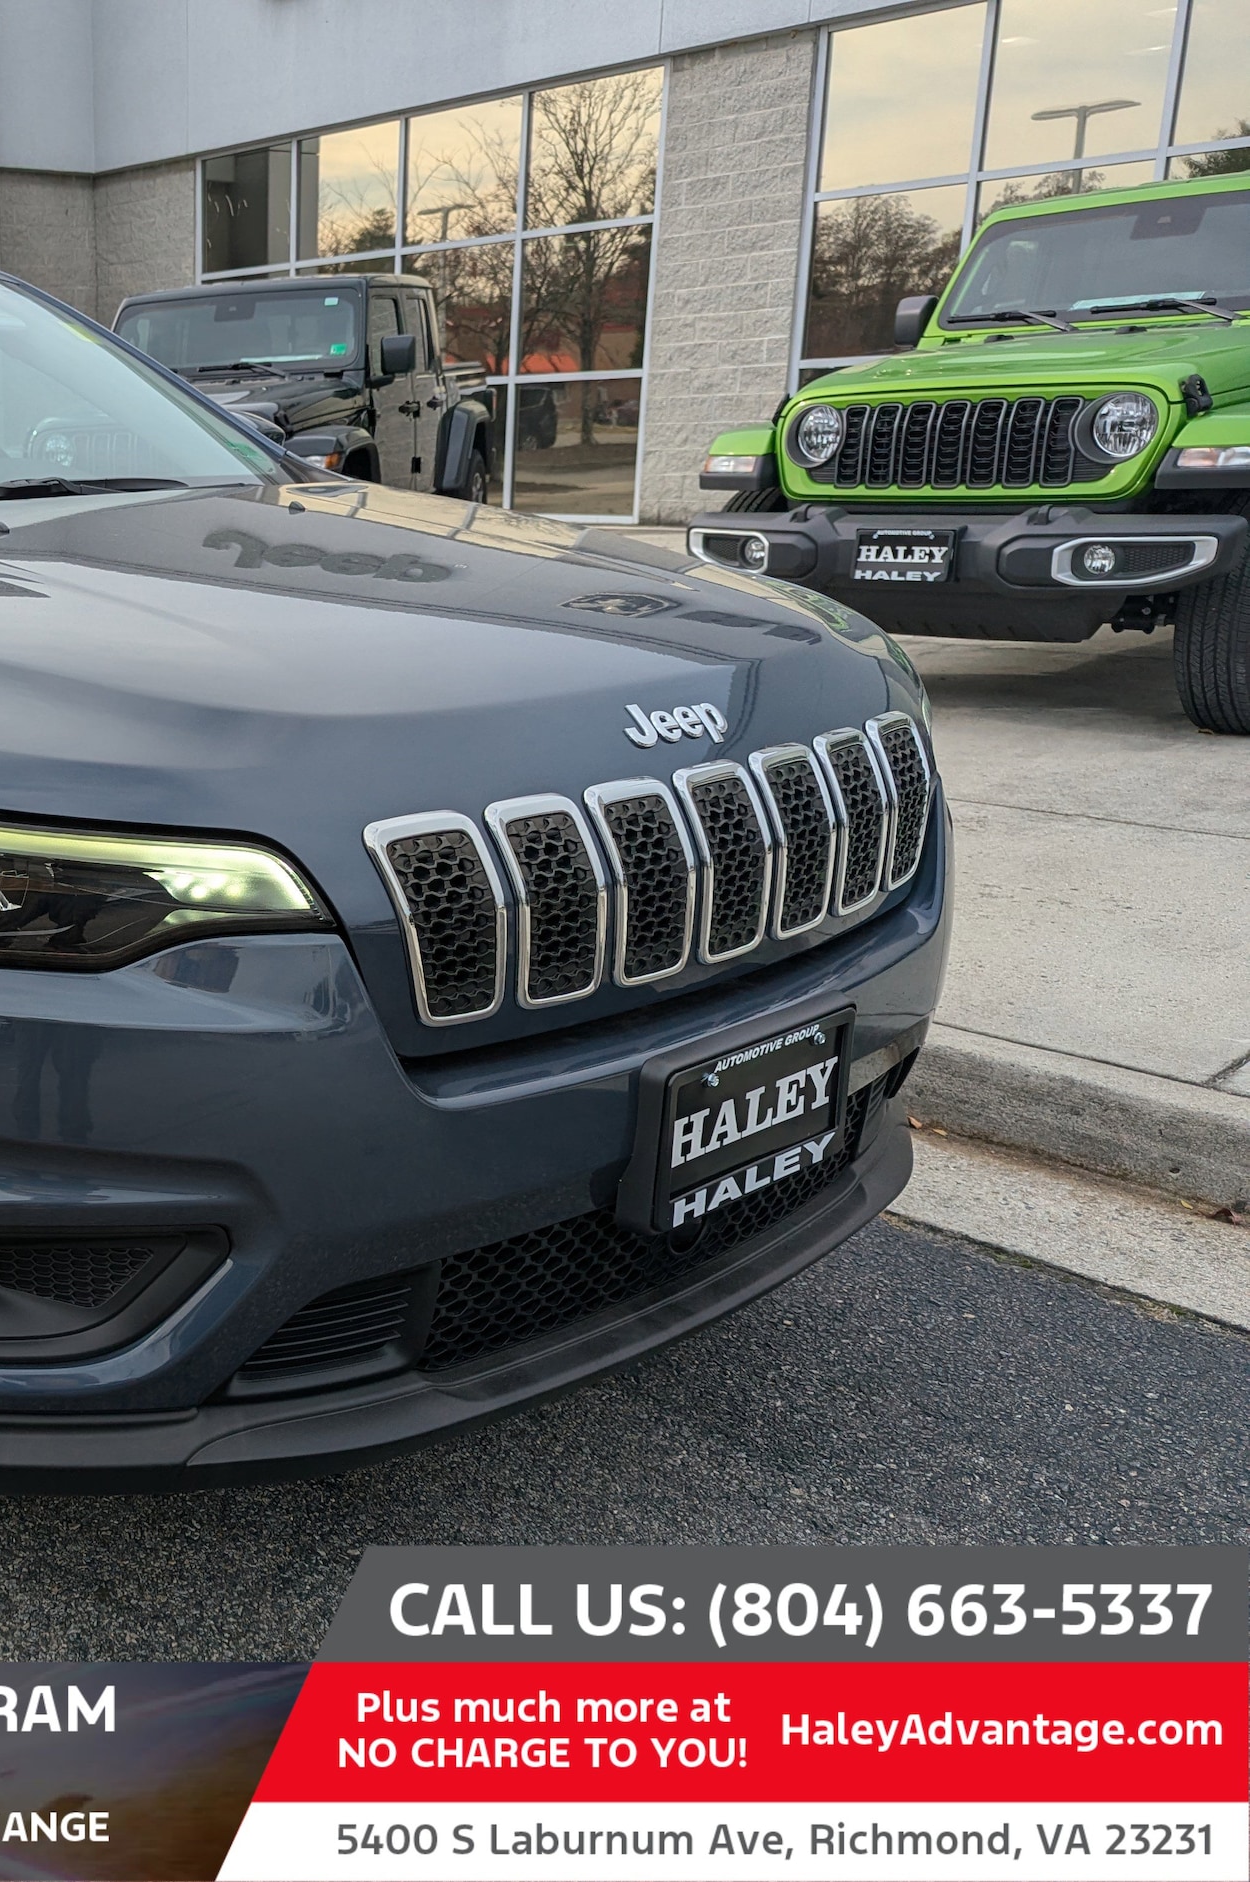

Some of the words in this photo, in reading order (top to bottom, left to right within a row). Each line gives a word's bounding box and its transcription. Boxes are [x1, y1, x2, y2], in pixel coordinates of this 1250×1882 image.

[854, 570, 941, 581] HALEY
[857, 546, 948, 563] HALEY
[623, 703, 728, 748] Jeep
[714, 1041, 782, 1073] AUTOMOTIVE
[784, 1024, 819, 1046] GROUP
[671, 1056, 838, 1168] HALEY
[672, 1132, 836, 1228] HALEY
